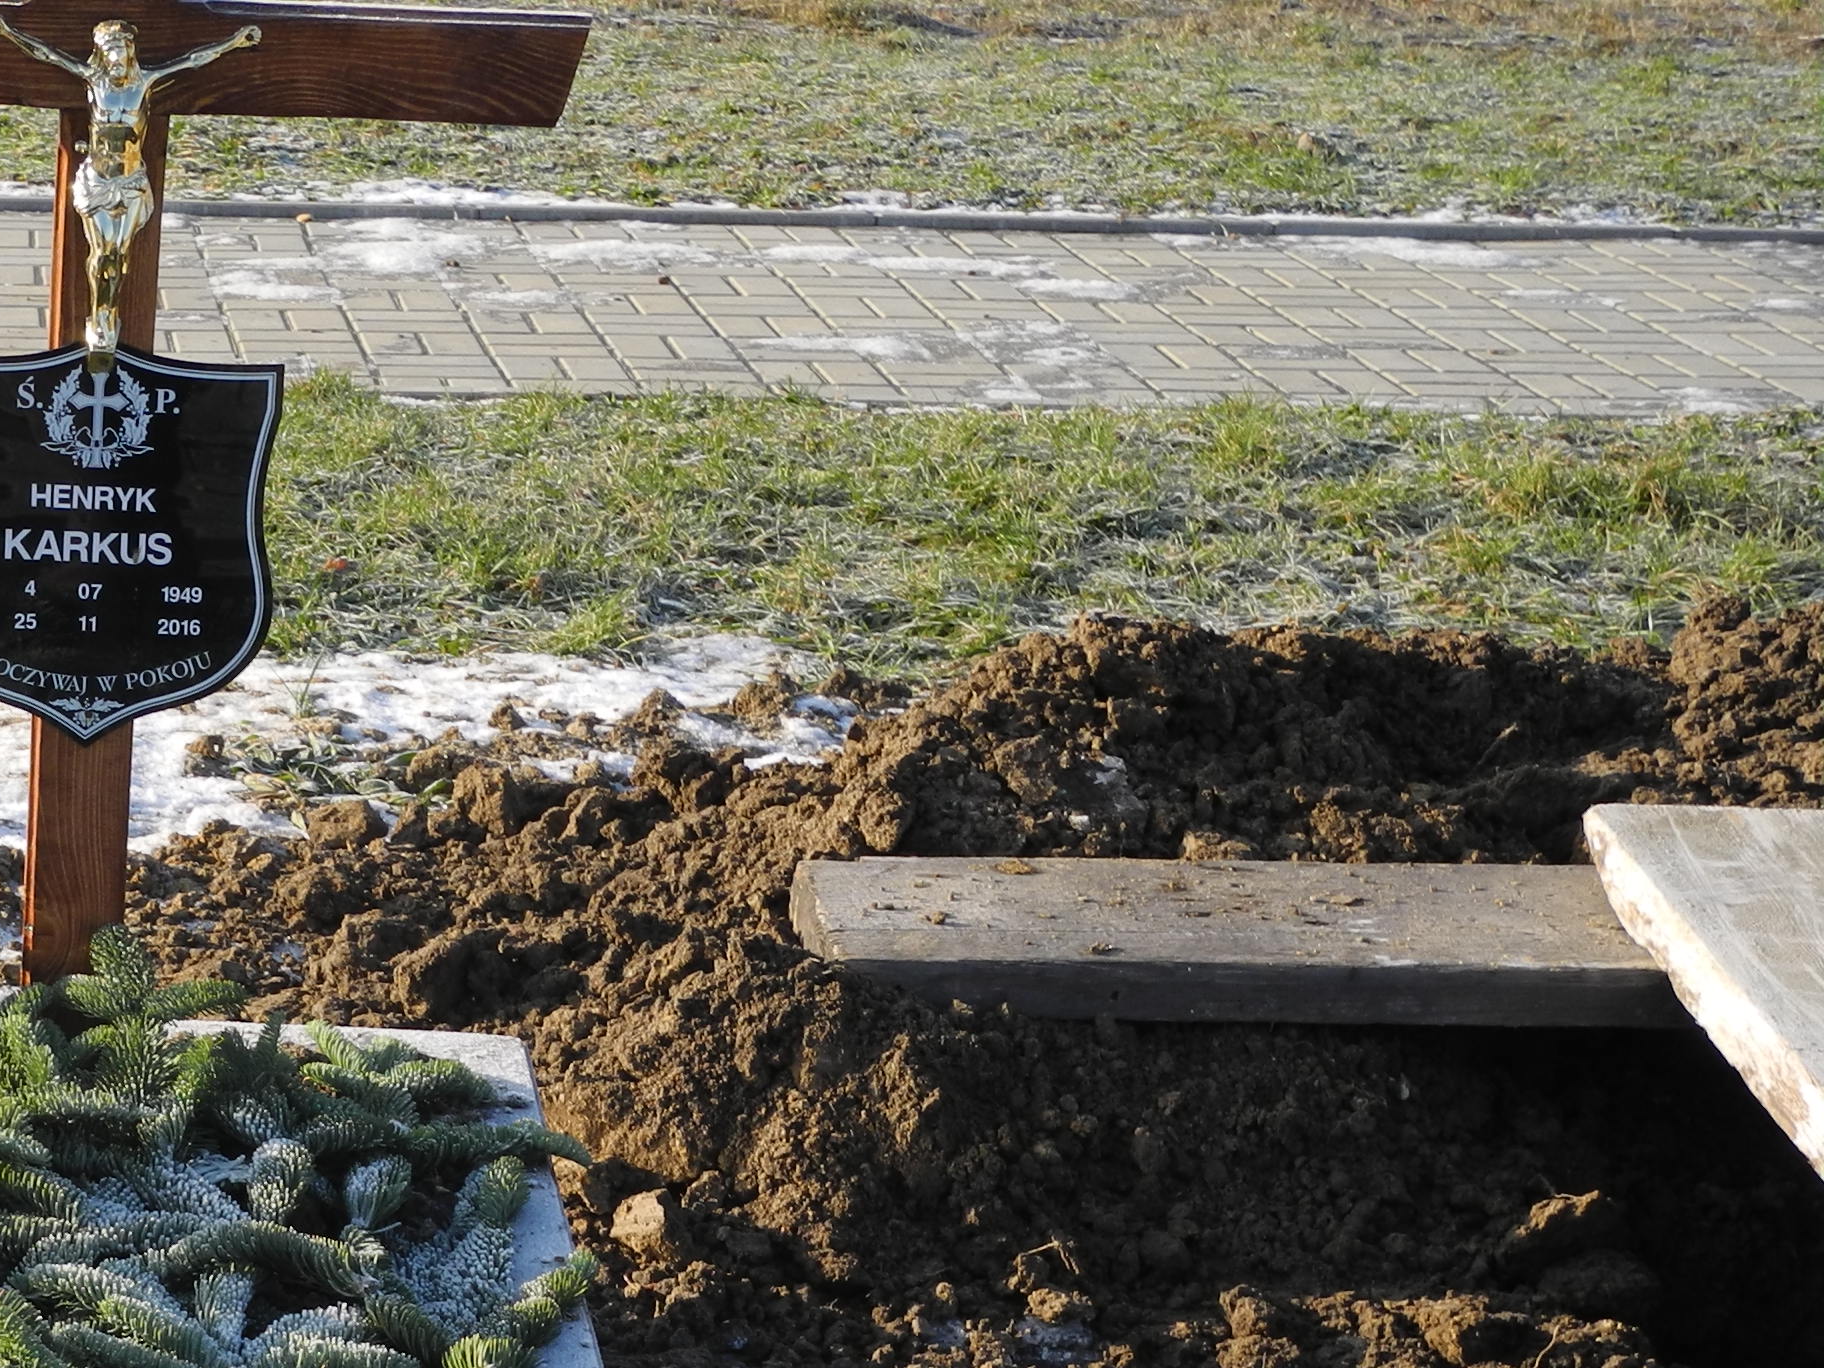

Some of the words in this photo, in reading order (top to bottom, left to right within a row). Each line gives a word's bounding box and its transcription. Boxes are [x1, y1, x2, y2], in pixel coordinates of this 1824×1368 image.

[155, 388, 180, 414] P.
[30, 483, 157, 513] HENRYK
[3, 528, 173, 566] KARKUS
[24, 580, 37, 597] 4
[78, 583, 103, 601] 07
[161, 586, 203, 604] 1949
[14, 613, 37, 630] 25
[78, 616, 97, 632] 11
[157, 618, 201, 636] 2016
[96, 675, 117, 692] W
[125, 651, 213, 690] POKOJU
